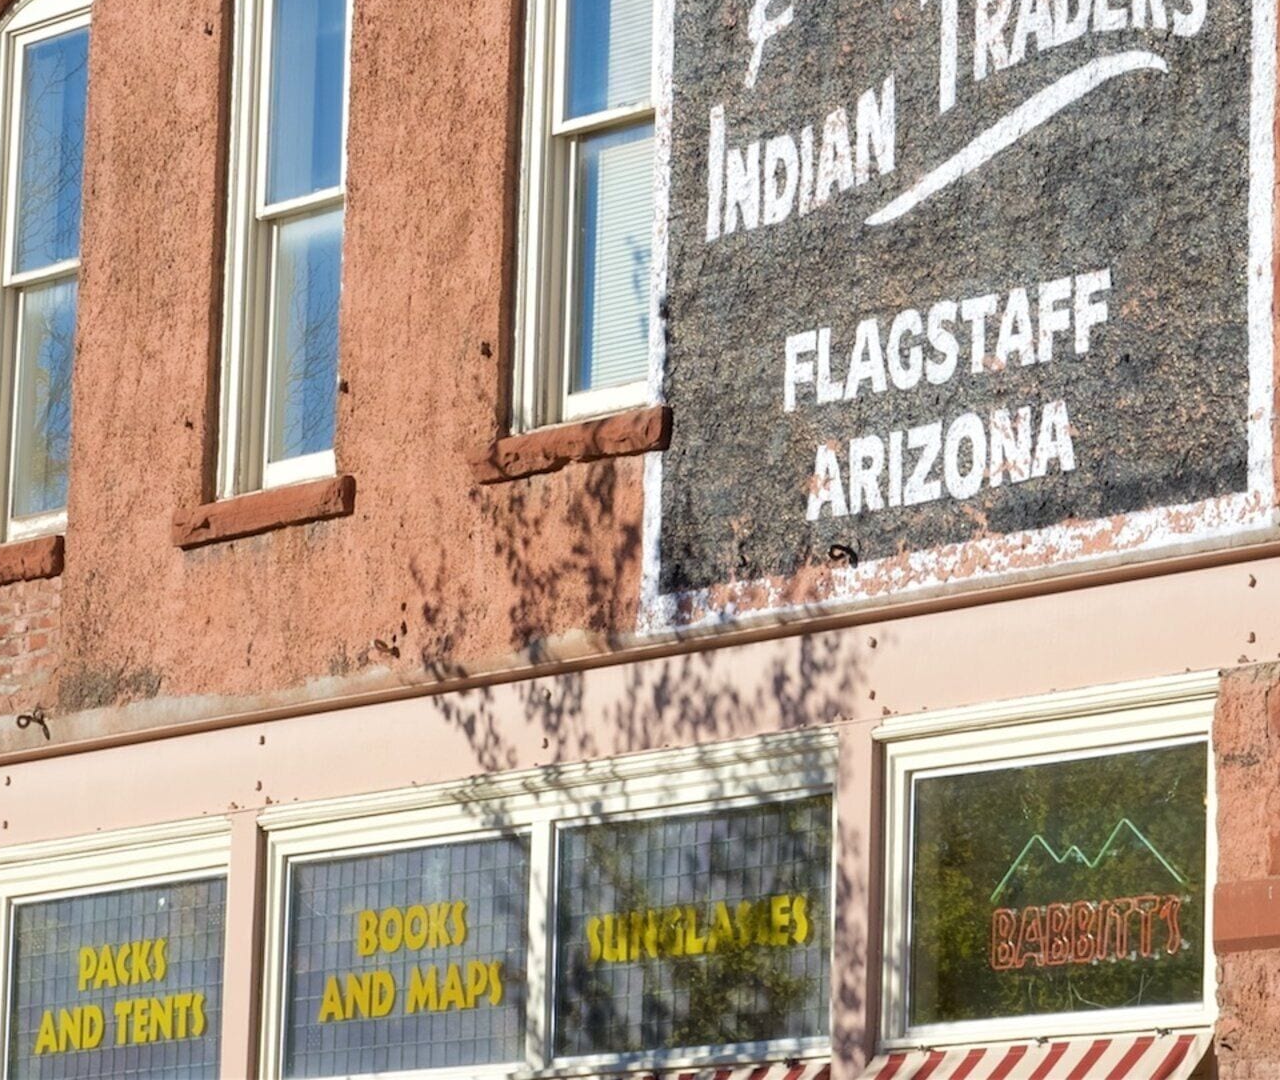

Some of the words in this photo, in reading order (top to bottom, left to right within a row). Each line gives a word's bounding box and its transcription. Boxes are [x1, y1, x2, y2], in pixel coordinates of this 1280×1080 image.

[705, 75, 896, 242] INDIAN
[783, 268, 1113, 412] FLAGSTAFF
[806, 399, 1076, 521] ARIZONA
[356, 900, 469, 957] BOOKS
[991, 894, 1181, 969] BABBITT'S
[76, 937, 168, 992] PACKS
[317, 970, 397, 1024] AND
[404, 960, 505, 1015] MAPS
[34, 1003, 105, 1055] AND
[113, 991, 206, 1046] TENTS
